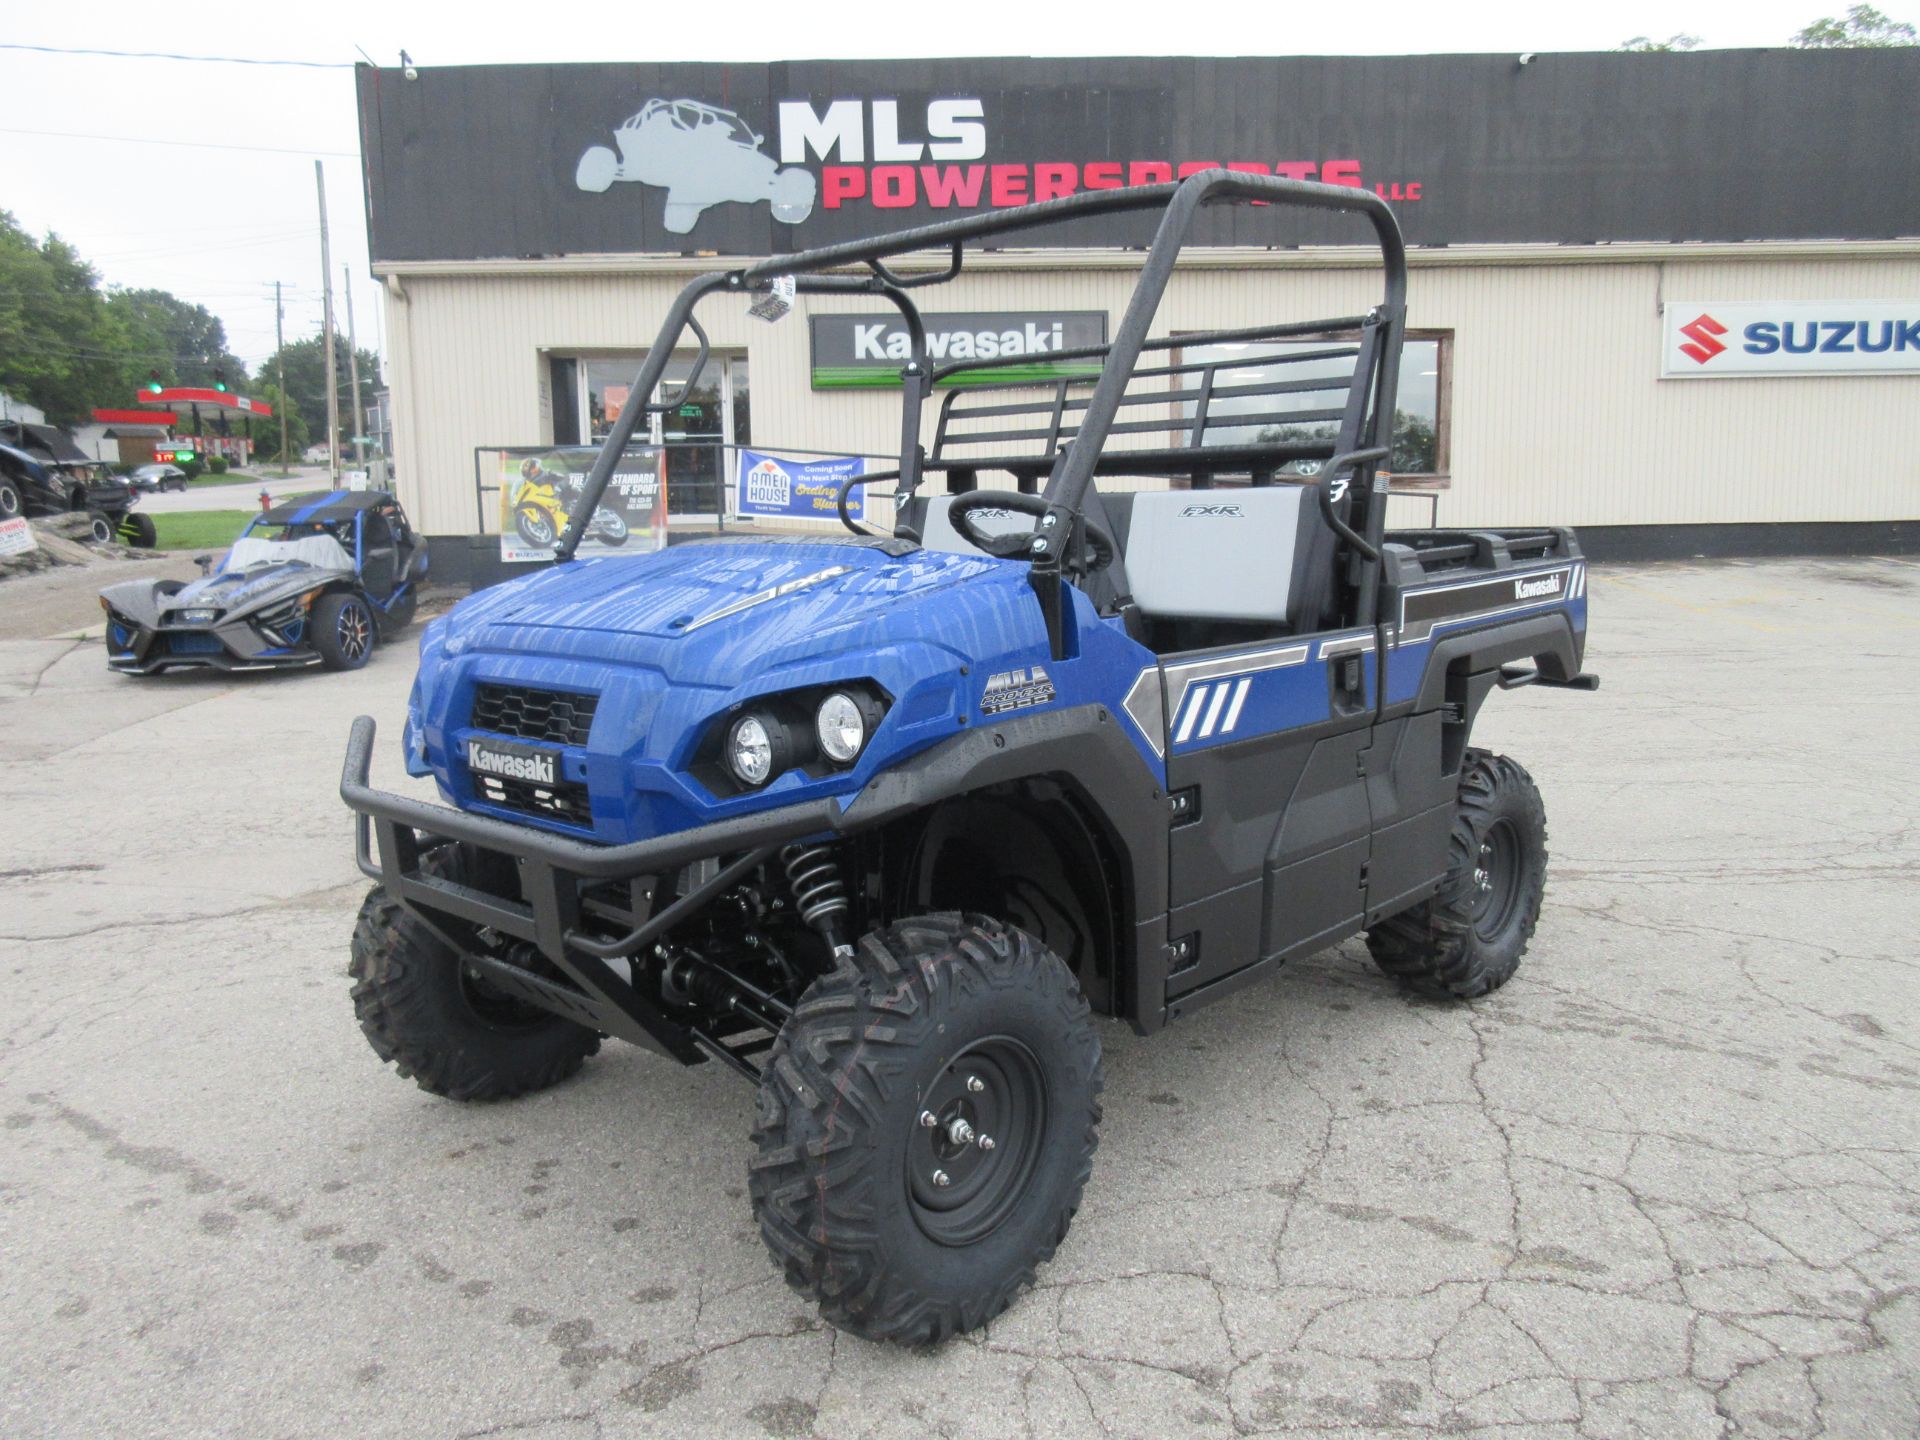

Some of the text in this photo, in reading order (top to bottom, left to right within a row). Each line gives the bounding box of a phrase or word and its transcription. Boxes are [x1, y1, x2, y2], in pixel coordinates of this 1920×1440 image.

[779, 99, 986, 163] MLS
[1376, 183, 1422, 201] LLC
[854, 322, 1064, 359] Kawasaki
[804, 464, 853, 474] Coming Soon
[569, 473, 585, 486] THE
[612, 473, 655, 485] STANDARD
[830, 474, 849, 483] Step
[620, 484, 659, 495] OF SPORT
[750, 487, 787, 502] HOUSE
[795, 484, 838, 499] Ending
[1181, 505, 1242, 517] FXR
[1515, 574, 1560, 599] Kawasaki
[983, 666, 1050, 696] MULE
[468, 742, 554, 784] Kawasaki
